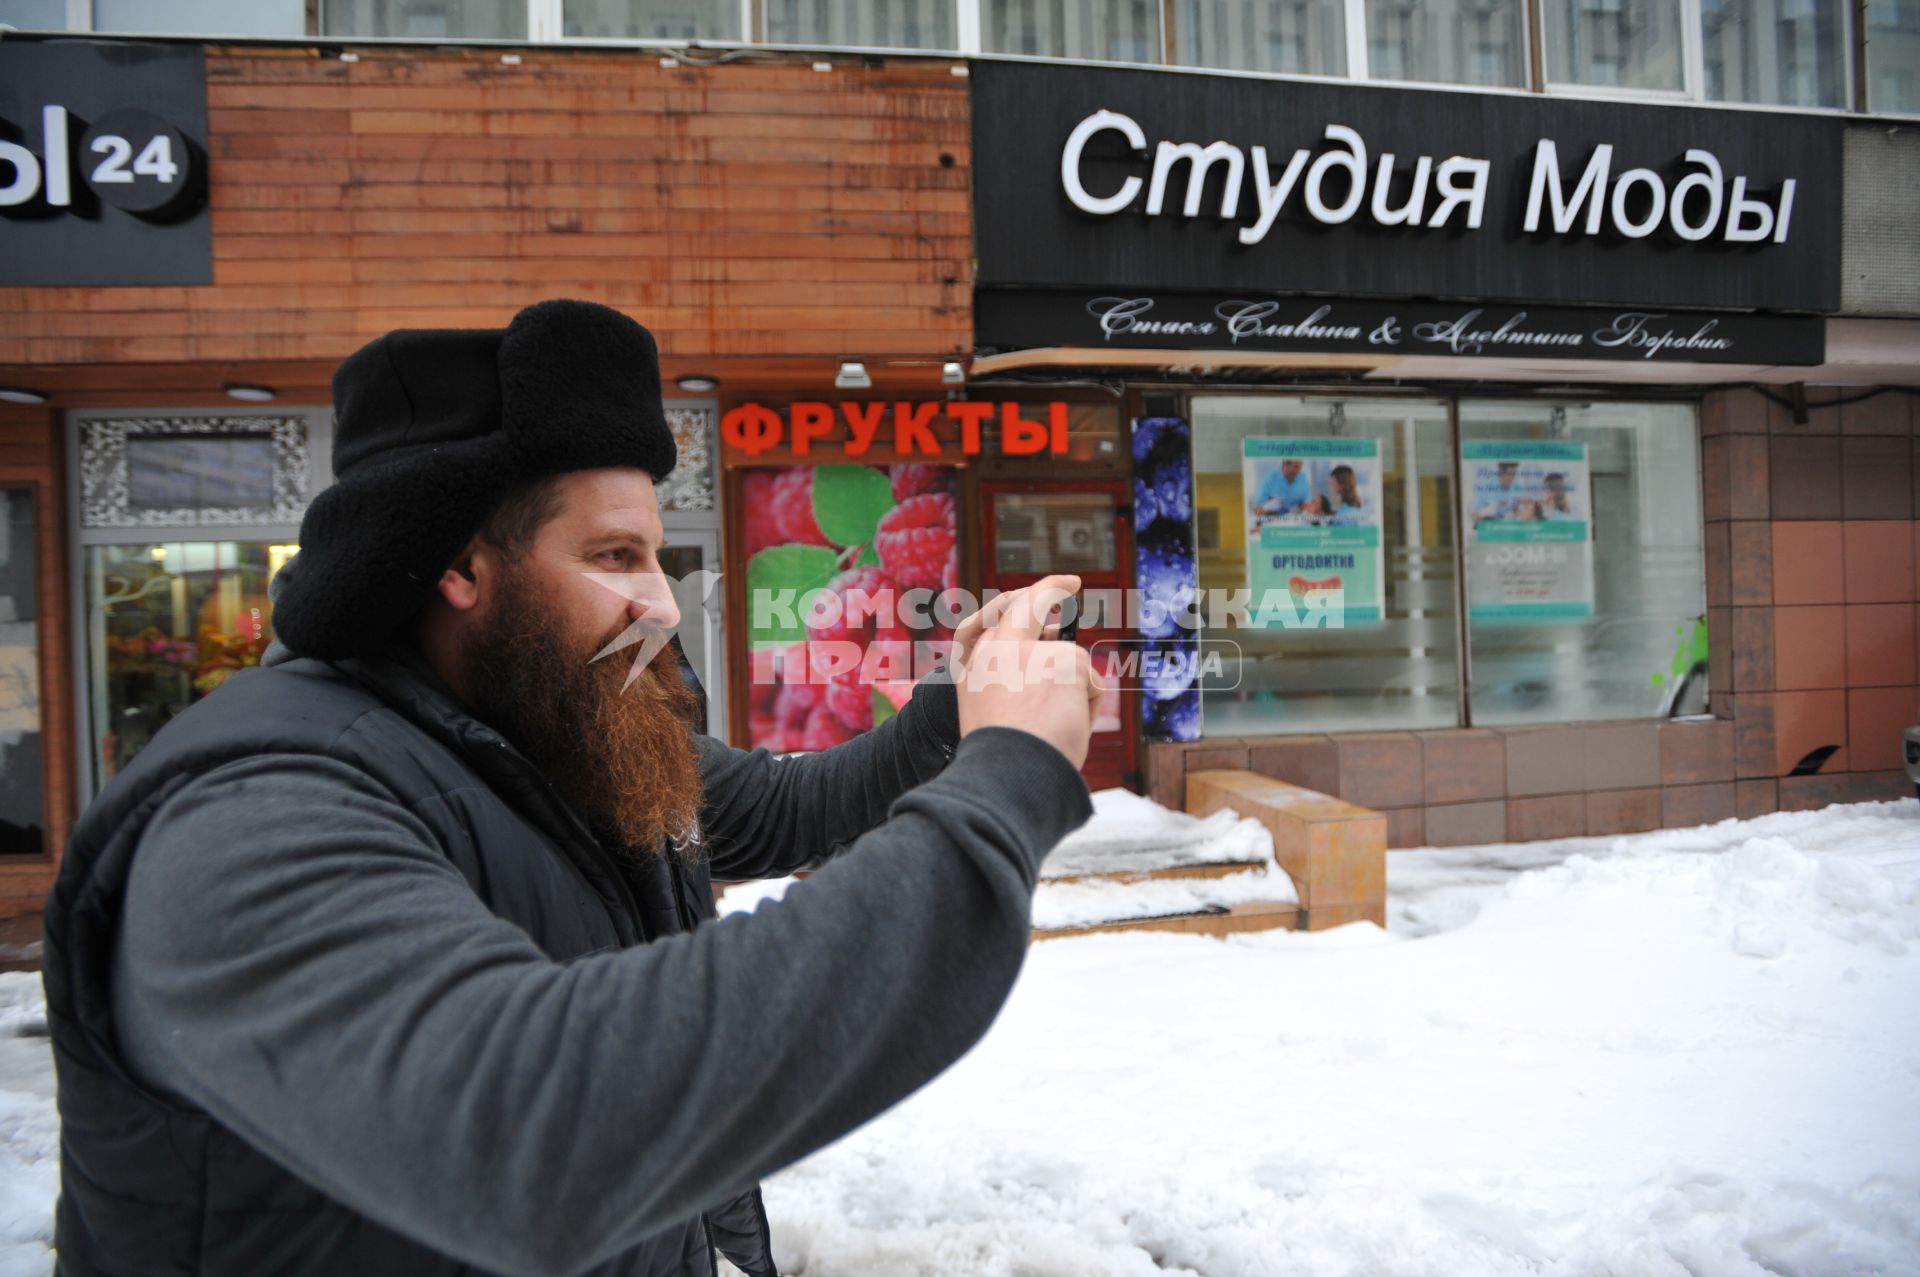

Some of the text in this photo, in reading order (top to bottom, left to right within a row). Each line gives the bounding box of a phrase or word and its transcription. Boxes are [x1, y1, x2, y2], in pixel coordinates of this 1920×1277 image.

[90, 134, 178, 184] 24
[1061, 109, 1797, 245] Студия Моды
[1214, 300, 1361, 344] Славина
[1368, 316, 1401, 344] &
[1412, 308, 1583, 354] Алевтина
[1592, 312, 1733, 359] Боровик
[720, 401, 1069, 456] ФРУКТЫ
[1272, 554, 1355, 569] ОРТОДОНТИЯ
